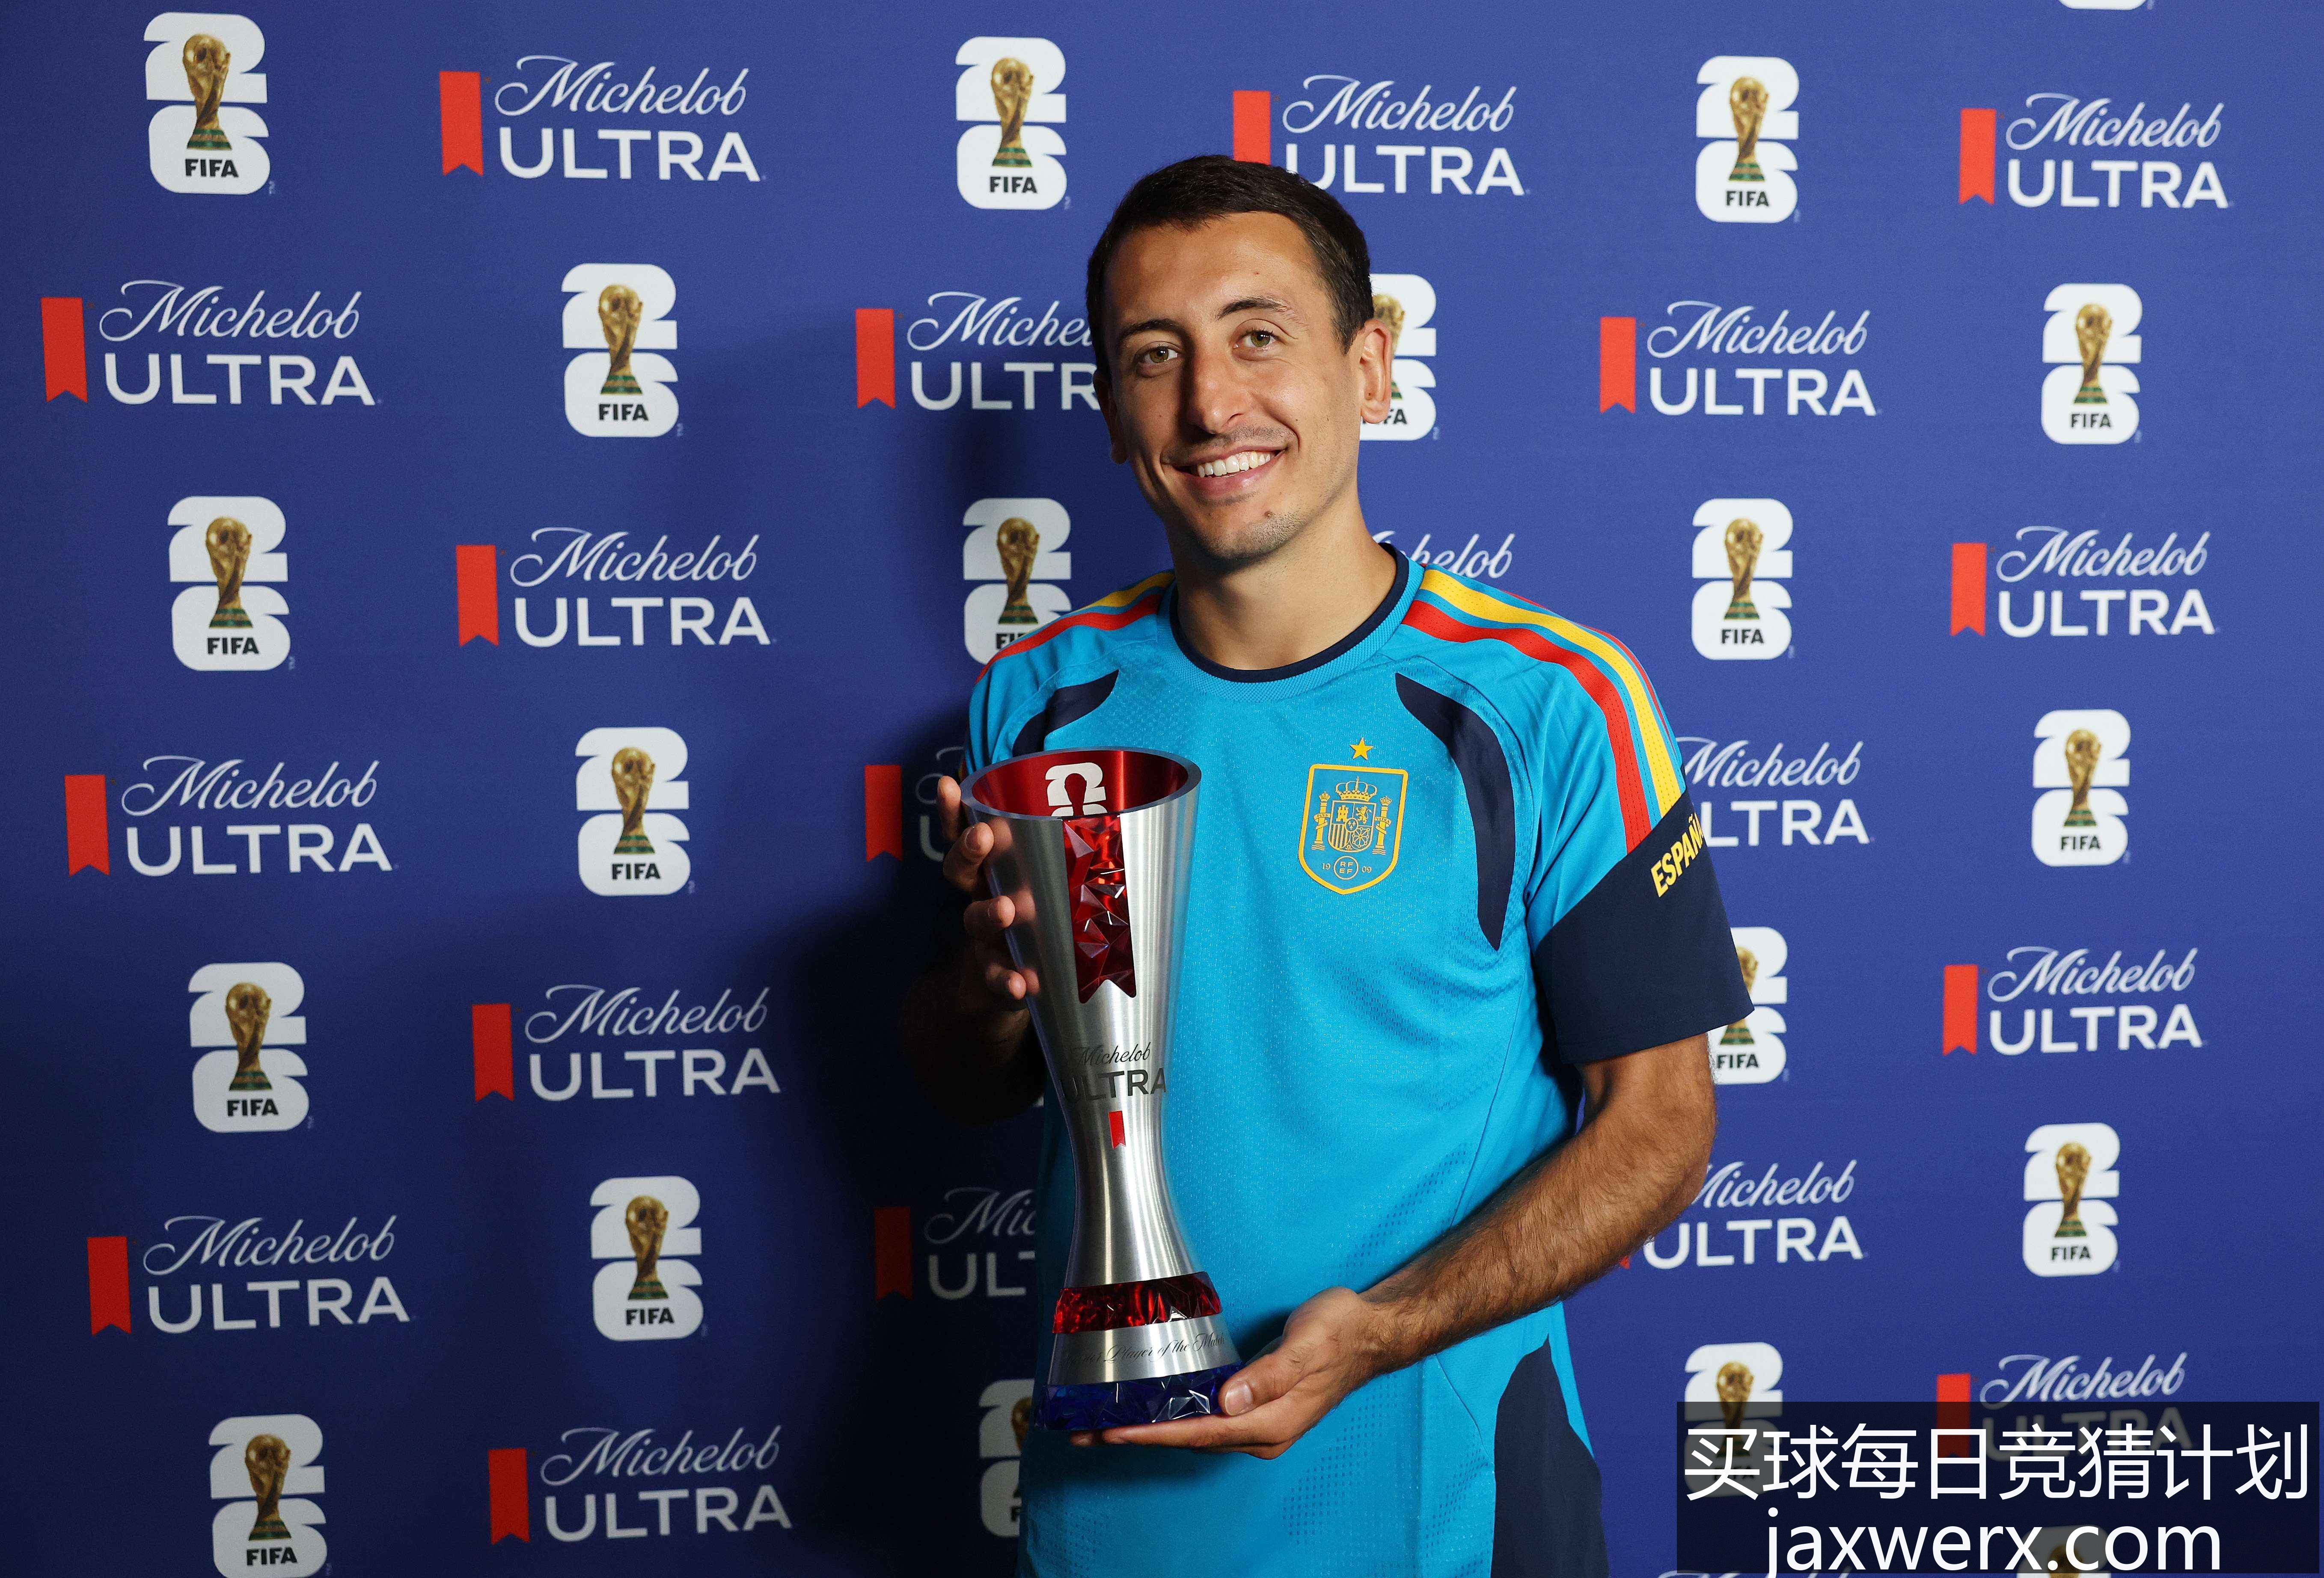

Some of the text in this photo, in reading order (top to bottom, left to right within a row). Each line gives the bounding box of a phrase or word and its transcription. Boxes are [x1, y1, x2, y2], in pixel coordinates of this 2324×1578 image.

[495, 56, 748, 116] Michelob
[1283, 75, 1516, 133] Michelob
[2006, 93, 2223, 150] Michelob
[185, 159, 238, 177] FIFA
[500, 128, 760, 181] ULTRA
[1286, 143, 1524, 195] ULTRA
[990, 176, 1037, 193] FIFA
[1727, 191, 1769, 206] FIFA
[2008, 159, 2228, 208] ULTRA
[100, 280, 361, 341] Michelob
[907, 291, 1092, 350] Miche
[1647, 301, 1869, 358] Michelob
[105, 353, 375, 405] ULTRA
[911, 361, 1101, 411] ULTR
[1650, 368, 1876, 415] ULTRA
[599, 404, 648, 421] FIFA
[2071, 414, 2111, 427] FIFA
[511, 528, 758, 587] Michelob
[1997, 526, 2210, 582] Michelob
[515, 597, 770, 647] ULTRA
[1722, 629, 1764, 644] FIFA
[1999, 590, 2215, 637] ULTRA
[208, 638, 259, 654] FIFA
[122, 756, 379, 816] Michelob
[1700, 798, 1870, 847] LTRA
[2061, 836, 2101, 850] FIFA
[127, 824, 392, 876] ULTRA
[612, 863, 660, 880] FIFA
[1988, 947, 2197, 1002] Michelob
[525, 985, 768, 1043] Michelob
[1990, 1004, 2202, 1055] ULTRA
[530, 1049, 779, 1100] ULTRA
[1717, 1054, 1758, 1069] FIFA
[227, 1099, 278, 1116] FIFA
[144, 1216, 396, 1275] Michelob
[1643, 1216, 1863, 1269] ULTRA
[2052, 1246, 2090, 1260] FIFA
[149, 1277, 410, 1333] ULTRA
[626, 1308, 674, 1325] FIFA
[1104, 1344, 1153, 1363] Player
[1156, 1340, 1174, 1360] of
[1979, 1352, 2188, 1410] Michelob
[541, 1426, 780, 1486] Michelob
[546, 1484, 791, 1542] ULTRA
[247, 1547, 297, 1566] FIFA
